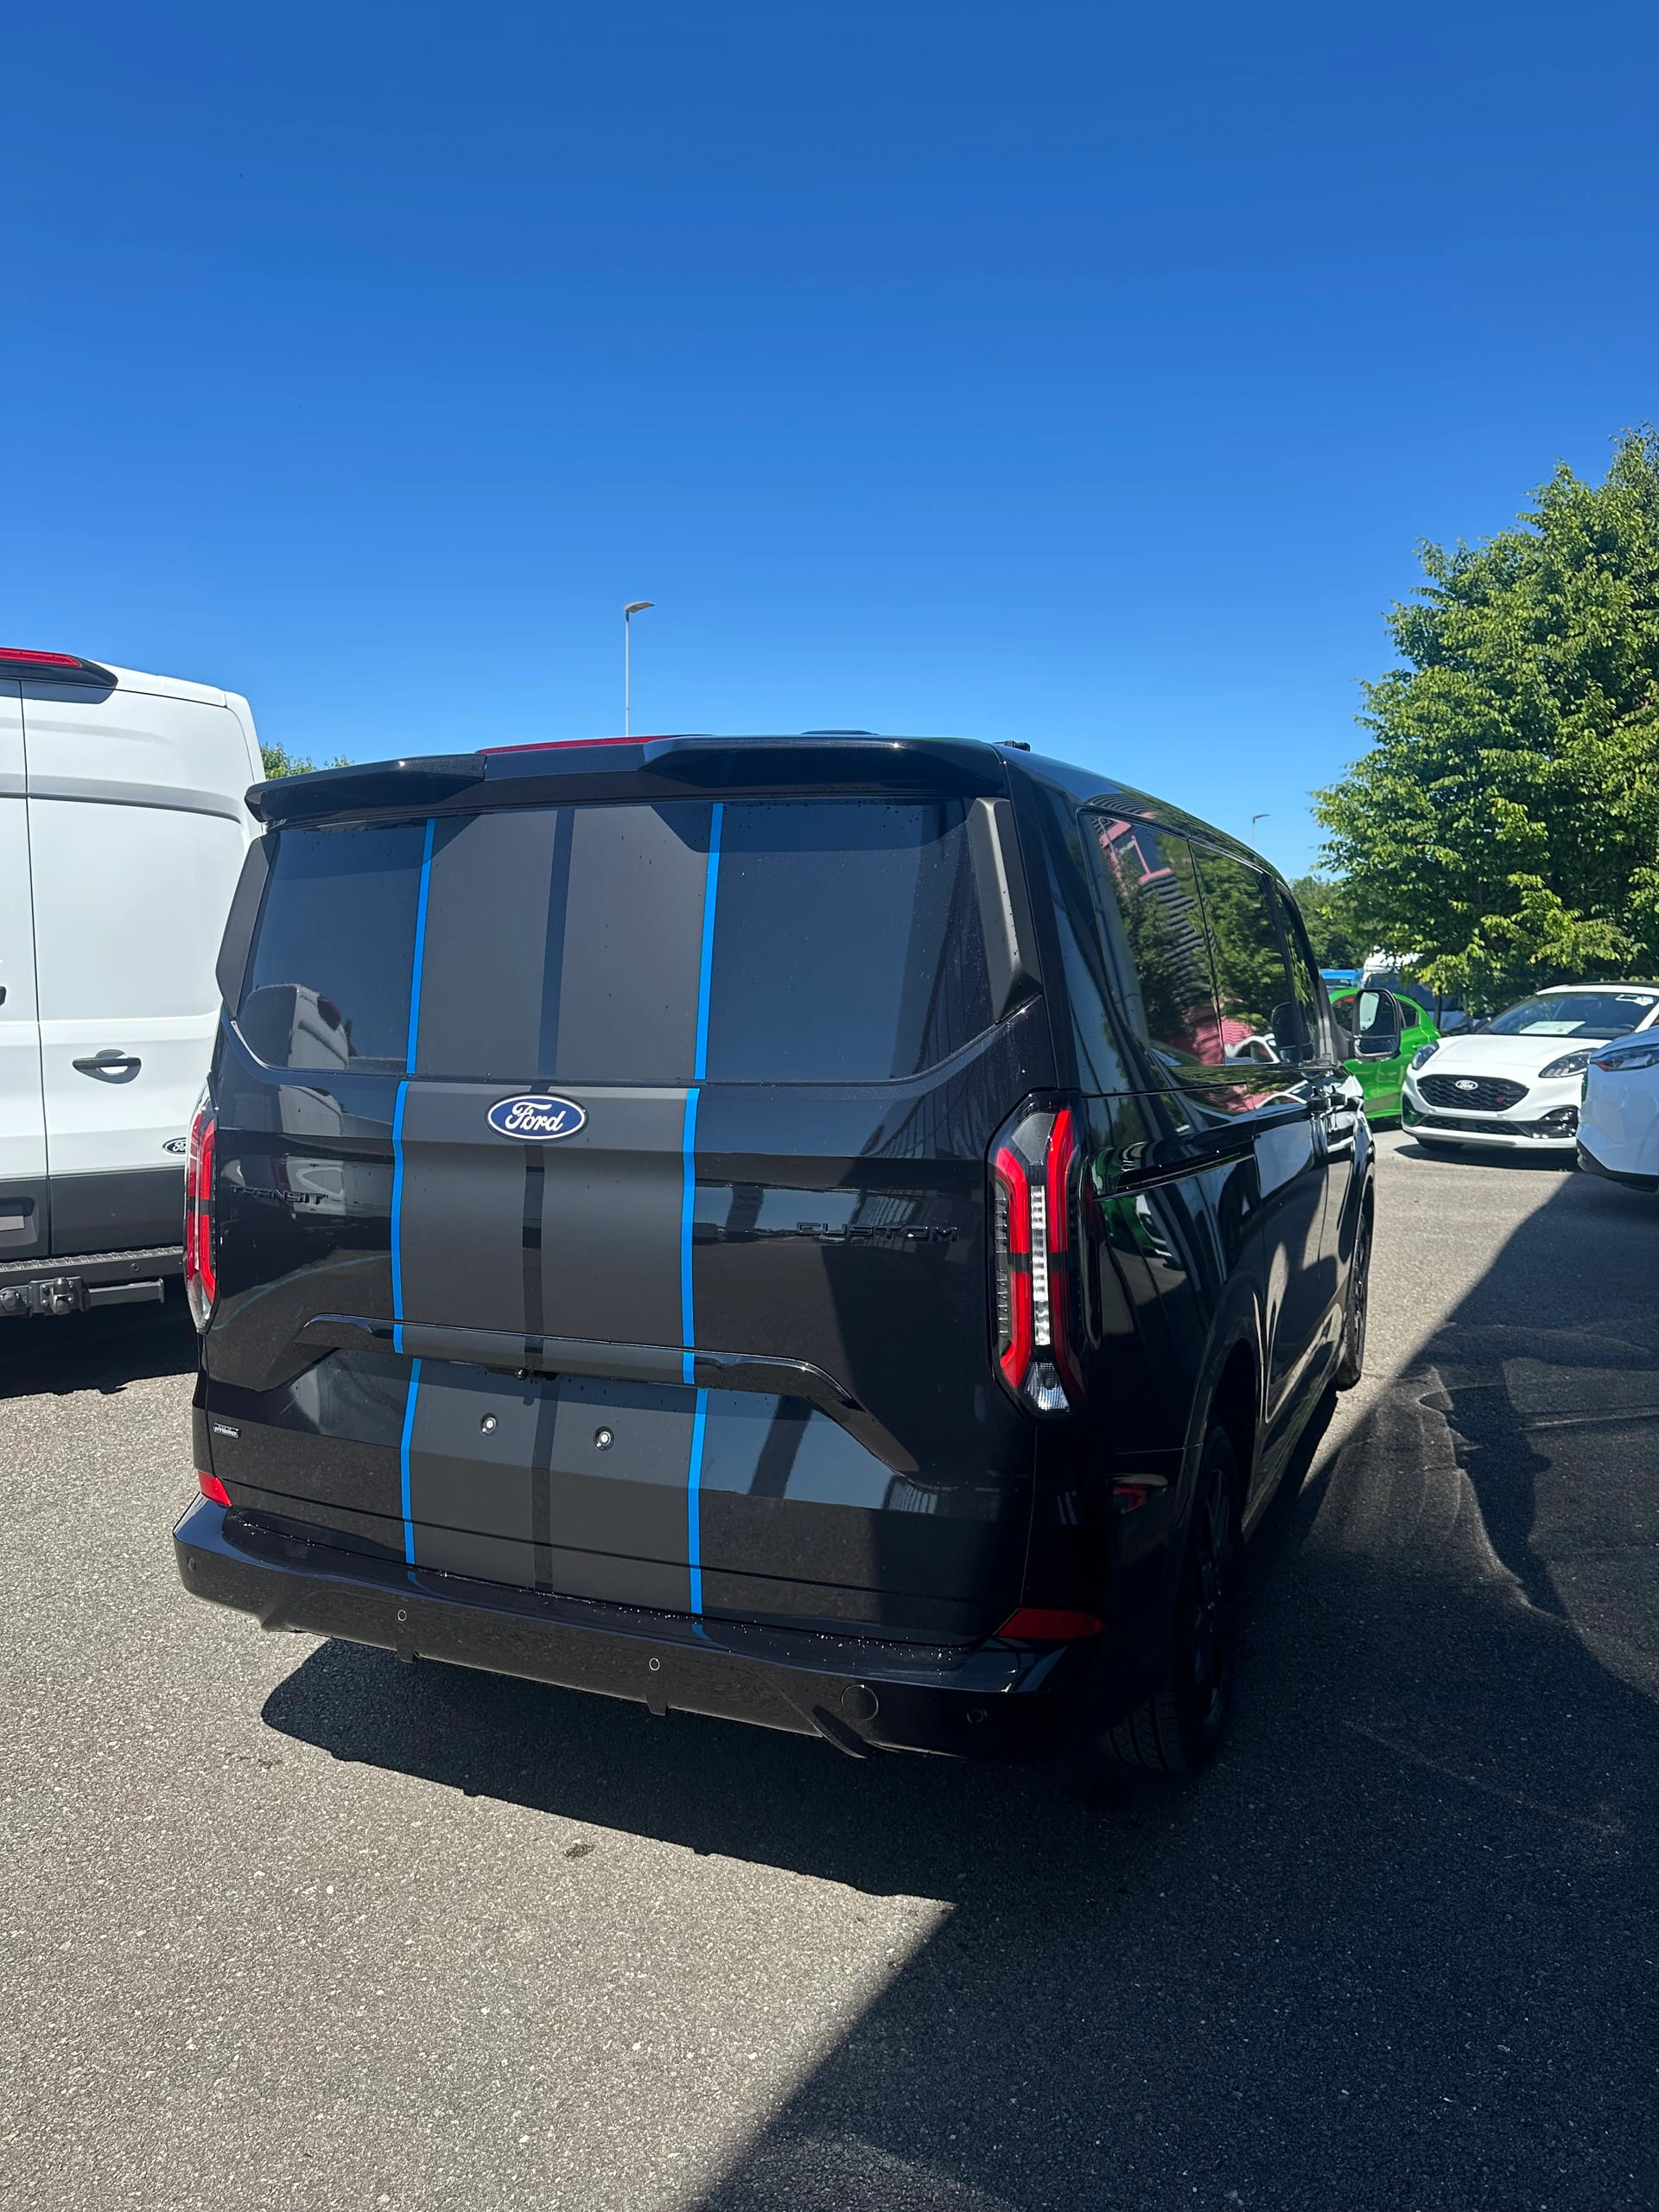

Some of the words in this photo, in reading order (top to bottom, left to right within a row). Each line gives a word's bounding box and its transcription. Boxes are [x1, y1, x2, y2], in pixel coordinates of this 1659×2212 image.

[505, 1101, 567, 1132] Ford
[230, 1185, 328, 1205] TRANSIT
[796, 1222, 958, 1243] CUSTOM
